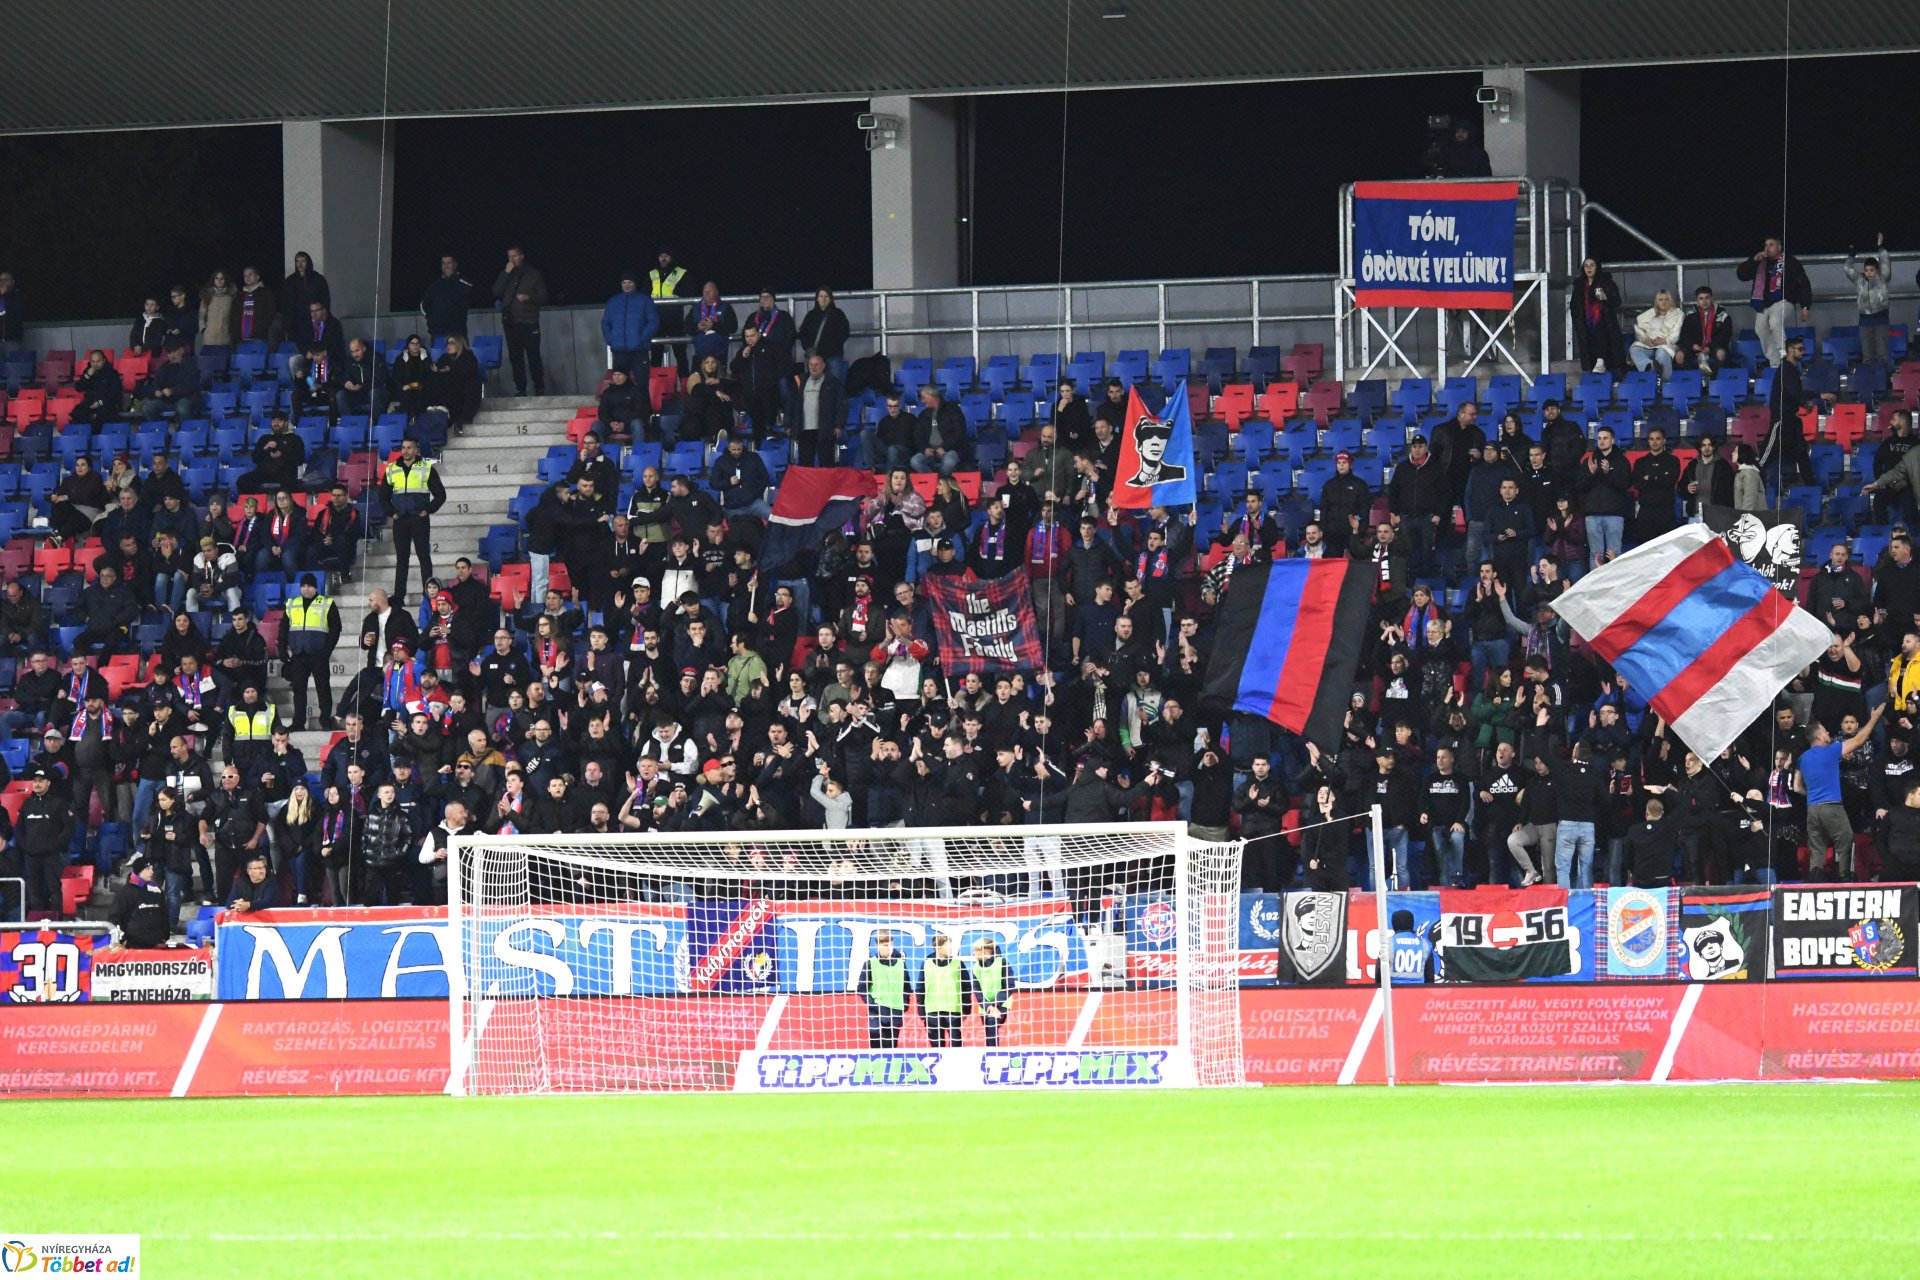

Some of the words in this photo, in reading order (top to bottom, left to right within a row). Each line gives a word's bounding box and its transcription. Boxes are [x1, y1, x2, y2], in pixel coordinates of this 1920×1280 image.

[1408, 208, 1460, 246] TÓNI,
[1361, 249, 1430, 283] ÖRÖKKÉ
[1433, 251, 1507, 285] VELÜNK!
[516, 425, 528, 435] 15
[486, 463, 498, 474] 14
[456, 503, 469, 514] 13
[948, 607, 1017, 637] Mastiffs
[960, 633, 1018, 663] Family
[332, 664, 345, 674] 09
[1489, 785, 1518, 794] adidas
[1783, 889, 1902, 921] EASTERN
[1314, 893, 1333, 955] NYSFC
[1449, 915, 1483, 945] 19
[1526, 908, 1565, 942] 56
[1783, 937, 1853, 966] BOYS
[95, 958, 207, 977] MAGYARORSZÁG
[1395, 949, 1423, 973] 001
[12, 942, 80, 1000] 30
[110, 985, 191, 1001] PETNEHÁZA
[1543, 998, 1583, 1009] VEGYI
[1587, 995, 1665, 1009] FOLYÉKONY
[1793, 1000, 1920, 1017] HASZONGÉPJÁ
[1250, 1007, 1362, 1024] LOGISZTIKA,
[1490, 1011, 1528, 1022] IPARI
[242, 1018, 355, 1035] RAKTÁROZÁS,
[362, 1019, 450, 1034] LOGISZTIK
[1808, 1019, 1920, 1034] KERESKEDEL
[17, 1040, 143, 1055] KERESKEDELEM
[273, 1032, 437, 1051] SZEMÉLYSZÁLLÍTÁS
[1427, 1052, 1502, 1072] RÉVÉSZ
[1509, 1056, 1576, 1072] TRANS
[1580, 1056, 1623, 1072] KFT.
[124, 1071, 160, 1086] KFT.
[242, 1067, 310, 1084] RÉVÉSZ
